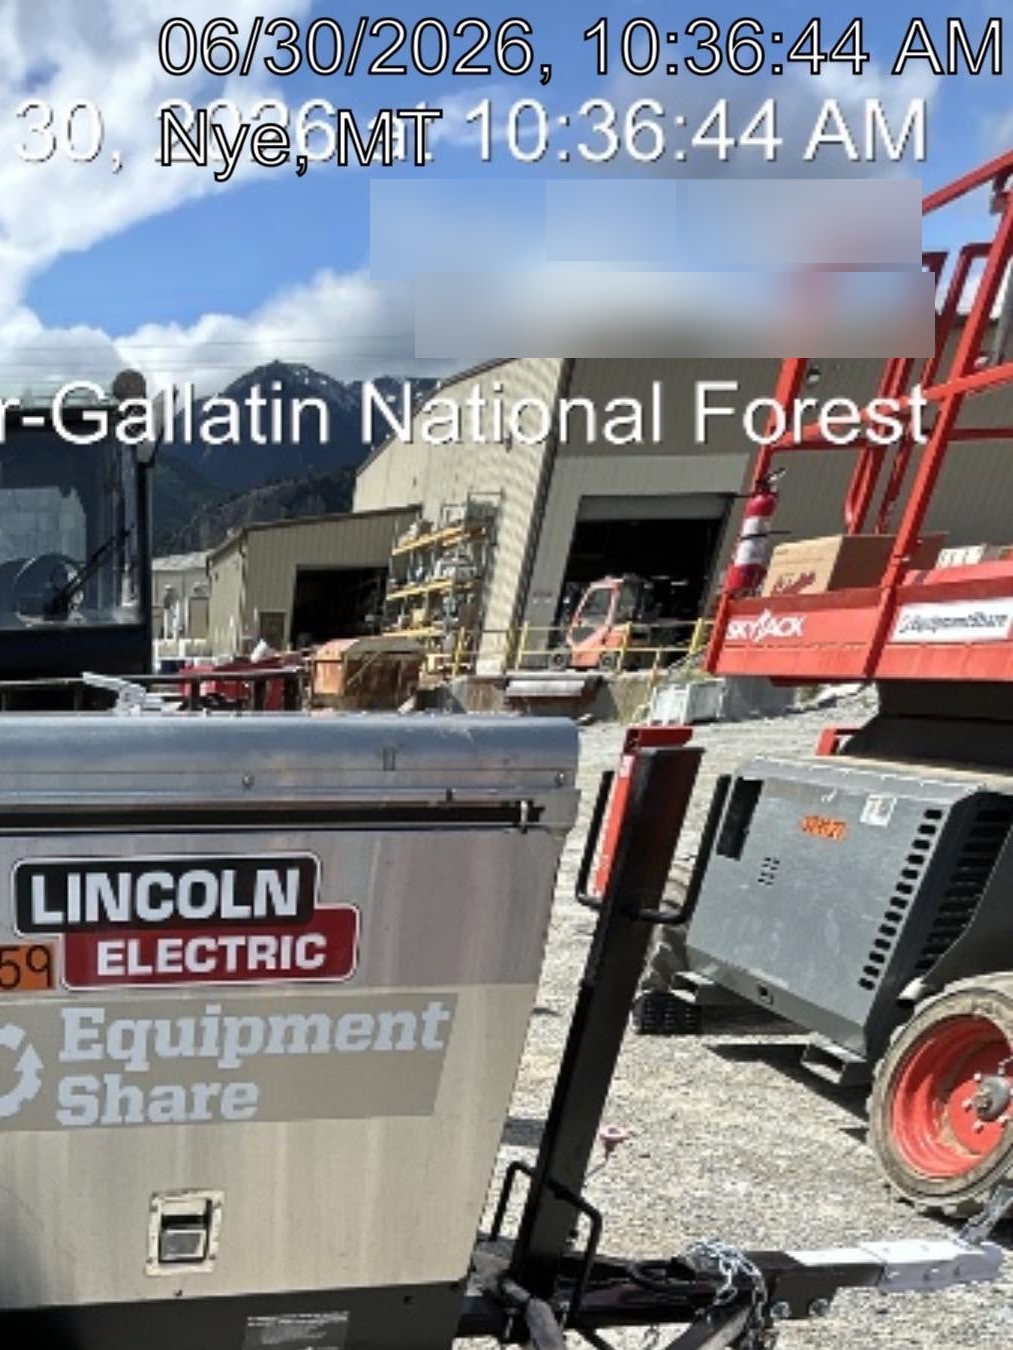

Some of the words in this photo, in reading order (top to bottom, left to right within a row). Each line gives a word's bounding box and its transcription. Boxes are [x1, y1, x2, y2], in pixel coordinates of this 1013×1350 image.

[31, 867, 300, 926] LINCOLN
[96, 933, 327, 977] ELECTRIC
[59, 1001, 451, 1069] Equipment
[56, 1075, 260, 1127] Share
